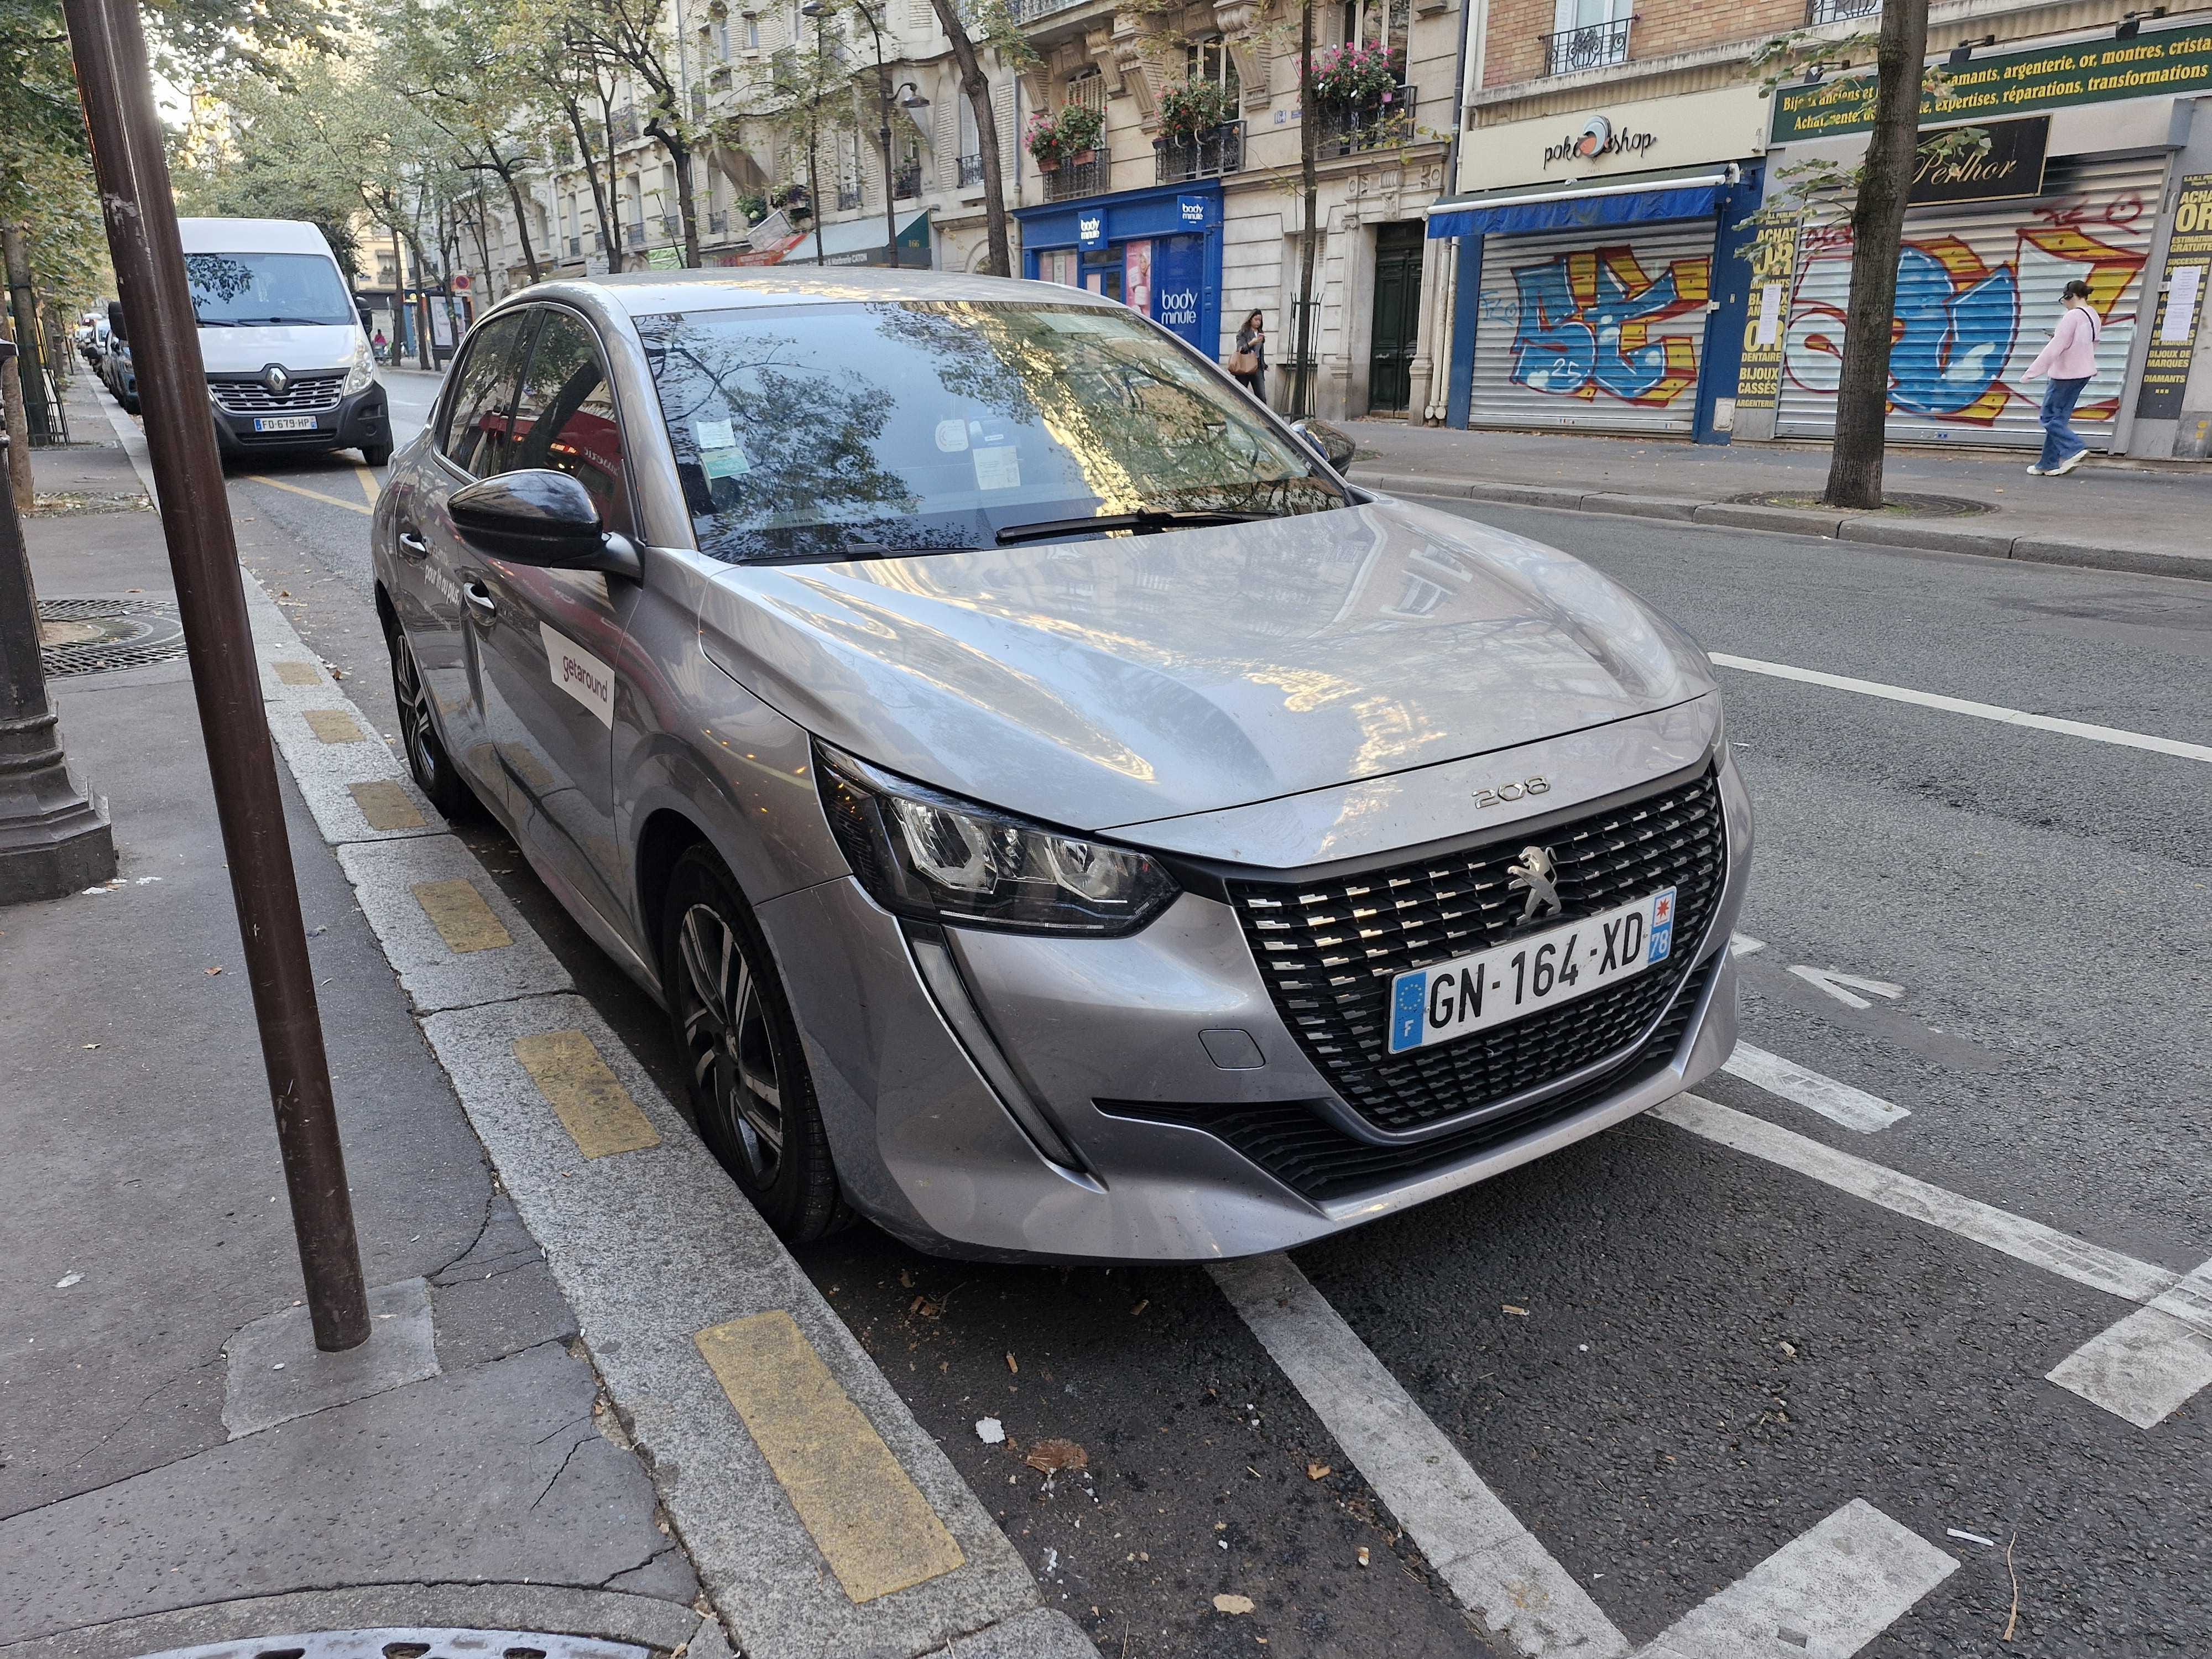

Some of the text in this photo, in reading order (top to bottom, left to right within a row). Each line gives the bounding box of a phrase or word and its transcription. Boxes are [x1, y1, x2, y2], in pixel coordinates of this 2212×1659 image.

[2004, 55, 2076, 80] argenterie,
[2079, 54, 2098, 68] or,
[2101, 44, 2165, 65] montres,
[2169, 36, 2212, 55] crista
[1935, 92, 1999, 113] expertises,
[2003, 81, 2084, 104] réparations,
[2088, 64, 2209, 92] transformations
[2179, 189, 2212, 204] ACHA
[1182, 203, 1203, 213] body
[1081, 217, 1100, 231] body
[2176, 202, 2212, 232] OR
[1081, 230, 1100, 239] minute
[1756, 227, 1797, 242] ACHAT
[1162, 288, 1198, 311] body
[1162, 310, 1197, 325] minute
[1741, 352, 1781, 362] DENTAIRE
[2148, 349, 2192, 358] BIJOUX DE
[2147, 359, 2189, 368] MARQUES
[1739, 367, 1779, 380] BIJOUX
[2143, 374, 2186, 383] DIAMANTS
[1738, 380, 1777, 394] CASSÉS
[1736, 399, 1775, 408] ARGENTERIE
[563, 655, 608, 704] getaround
[1472, 776, 1551, 810] 208
[1650, 929, 1669, 959] 78
[1428, 911, 1643, 1029] GN-164-XD
[1404, 1019, 1415, 1037] F
